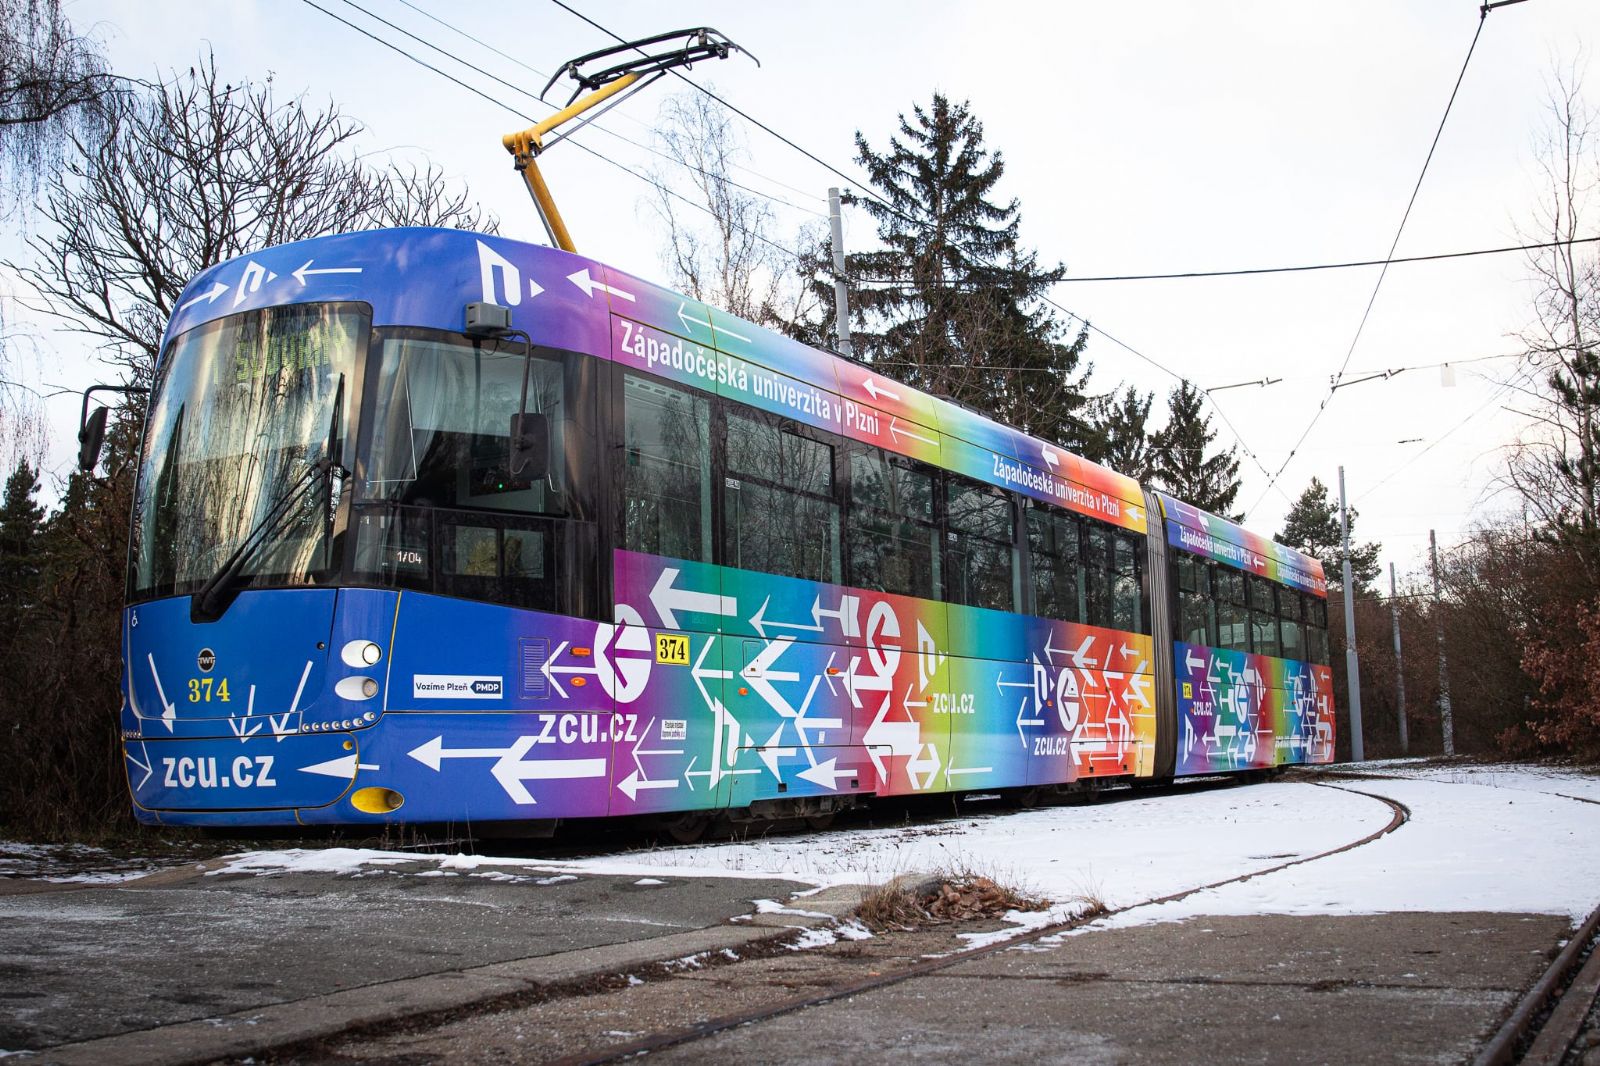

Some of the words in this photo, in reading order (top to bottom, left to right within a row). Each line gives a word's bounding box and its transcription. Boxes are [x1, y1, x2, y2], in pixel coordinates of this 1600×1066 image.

[620, 320, 748, 392] Západočeská
[753, 373, 831, 420] univerzita
[835, 403, 842, 424] v
[846, 401, 879, 436] Plzni
[992, 454, 1053, 495] Západočeská
[1055, 481, 1094, 509] univerzita
[1095, 497, 1101, 512] v
[1102, 494, 1120, 517] Plzni
[397, 550, 421, 564] 1/04
[660, 638, 685, 660] 374
[188, 677, 230, 703] 374
[447, 682, 468, 691] Plzeň
[476, 683, 499, 692] PMDP
[933, 692, 975, 714] zcu.cz
[538, 713, 638, 744] zcu.cz
[1034, 737, 1067, 756] zcu.cz
[162, 755, 277, 788] zcu.cz
